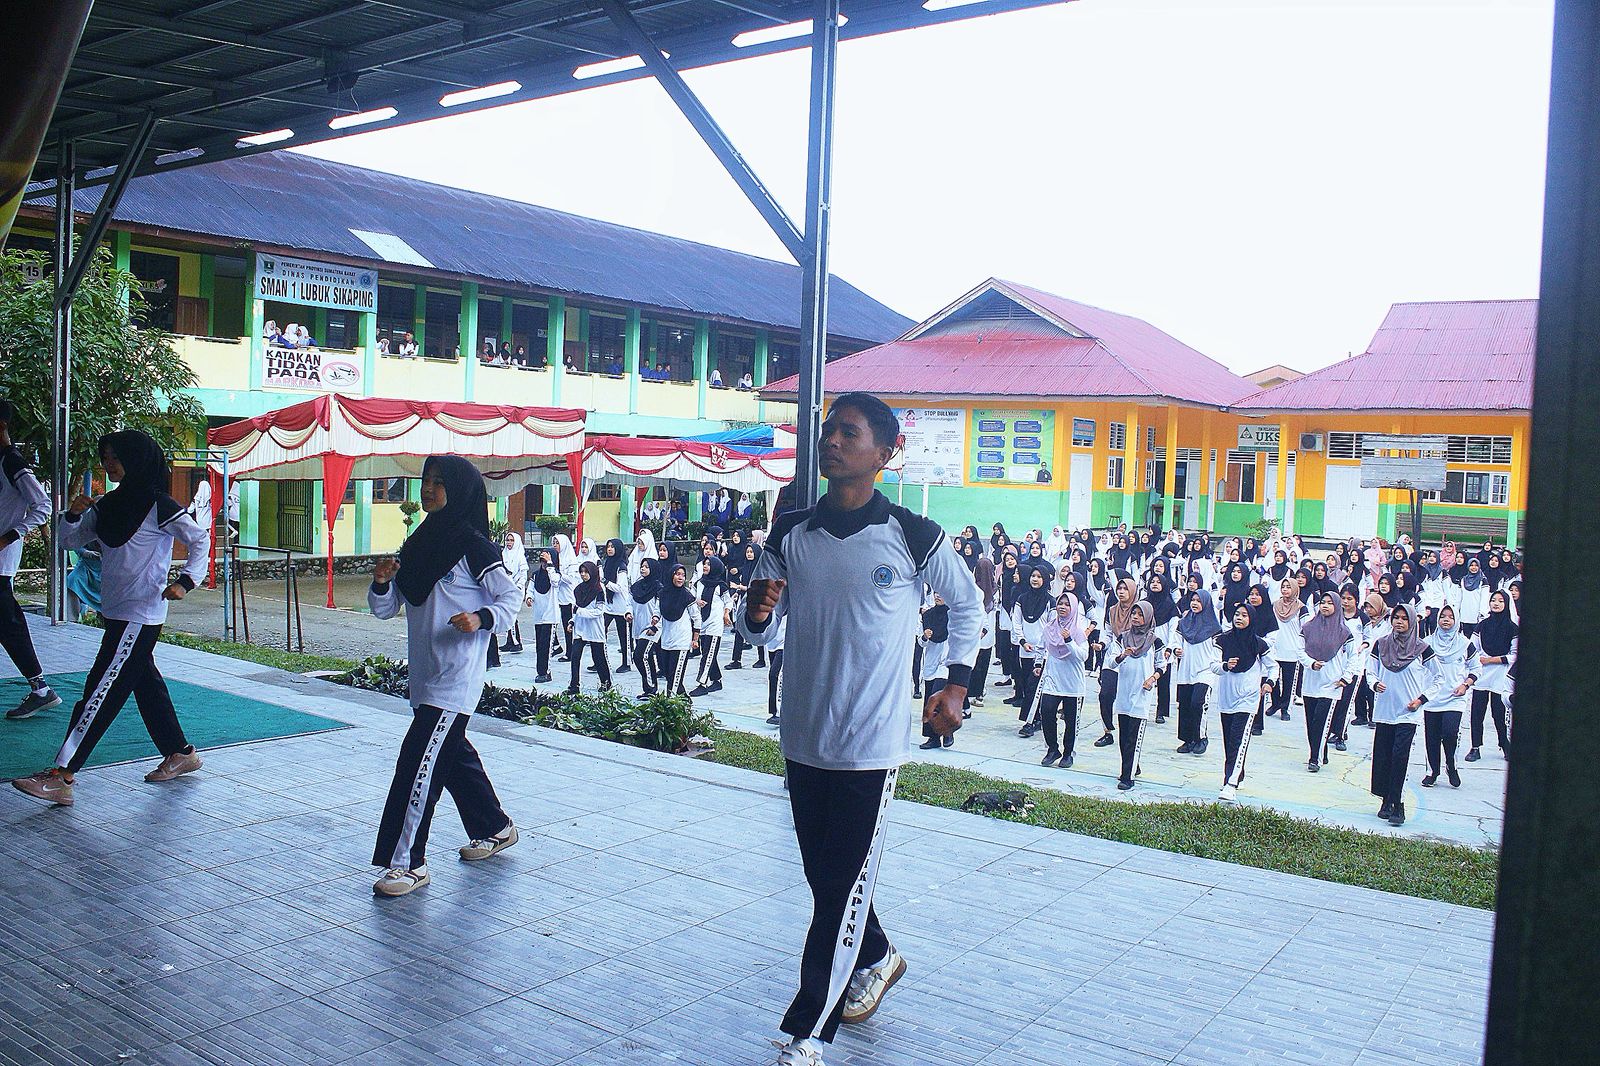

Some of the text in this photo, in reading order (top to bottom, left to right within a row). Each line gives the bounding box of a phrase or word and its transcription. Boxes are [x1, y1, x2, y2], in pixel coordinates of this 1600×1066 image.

[26, 266, 39, 277] 15
[282, 270, 356, 286] DINAS PENDIDIKAN
[260, 276, 374, 308] SMAN 1 LUBUK SIKAPING
[266, 350, 321, 366] KATAKAN
[266, 357, 320, 371] TIDAK
[267, 368, 321, 383] PADA
[1255, 431, 1280, 442] UKS
[120, 633, 134, 655] SMA
